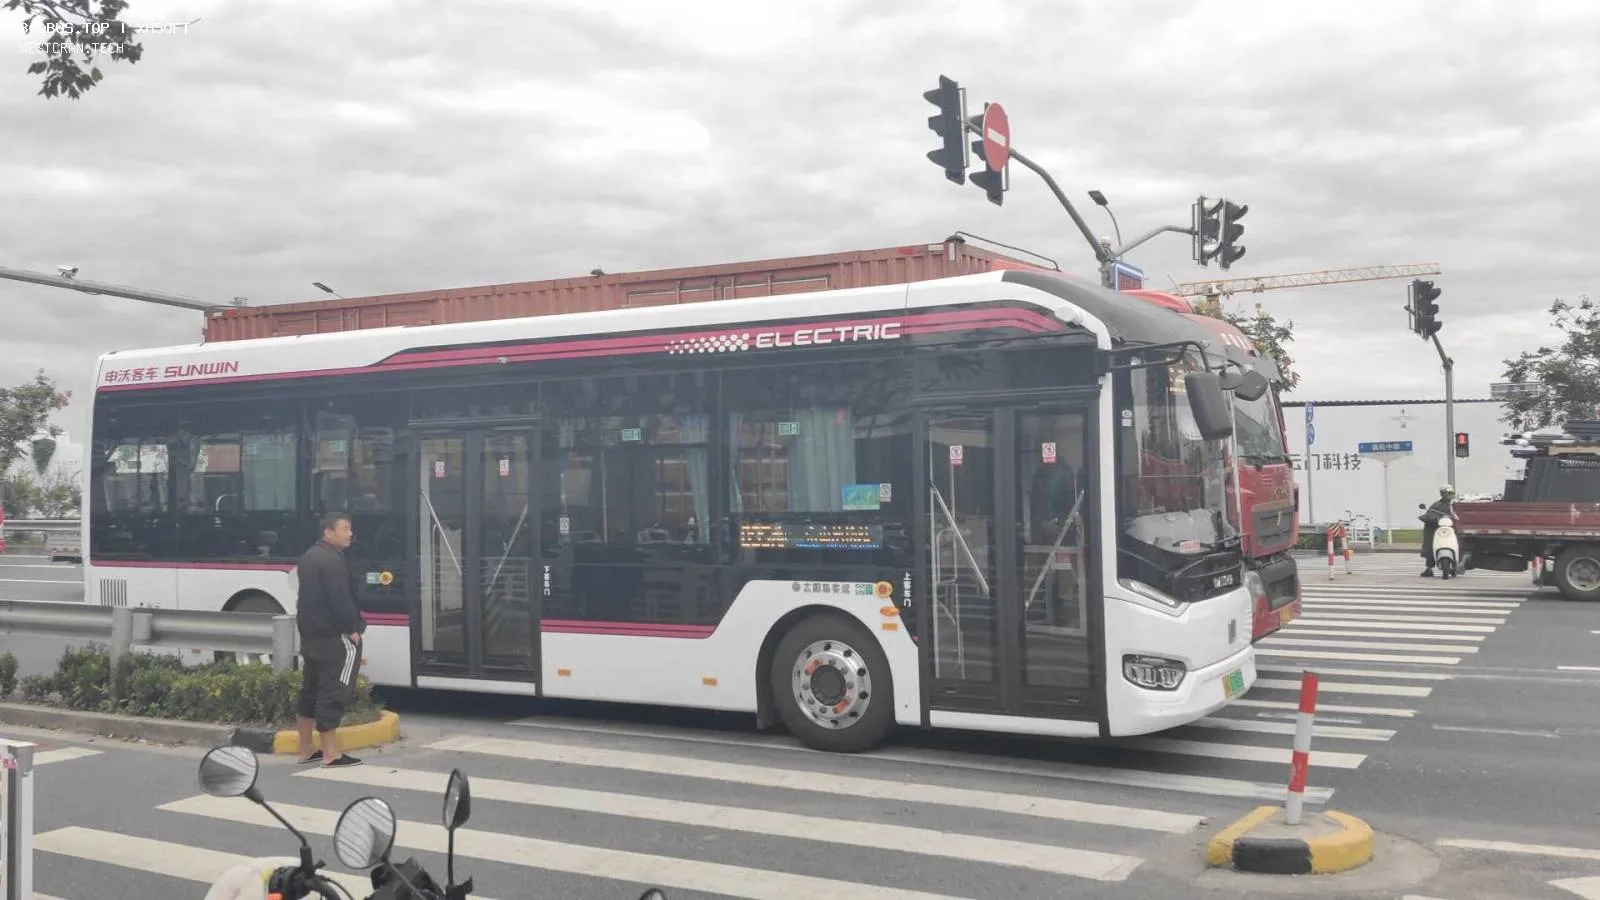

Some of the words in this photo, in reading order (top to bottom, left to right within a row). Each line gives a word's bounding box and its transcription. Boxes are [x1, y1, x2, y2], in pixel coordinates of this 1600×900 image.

[755, 322, 901, 348] ELECTRIC
[104, 367, 158, 383] 申沃客车
[163, 360, 239, 378] SUNWIN
